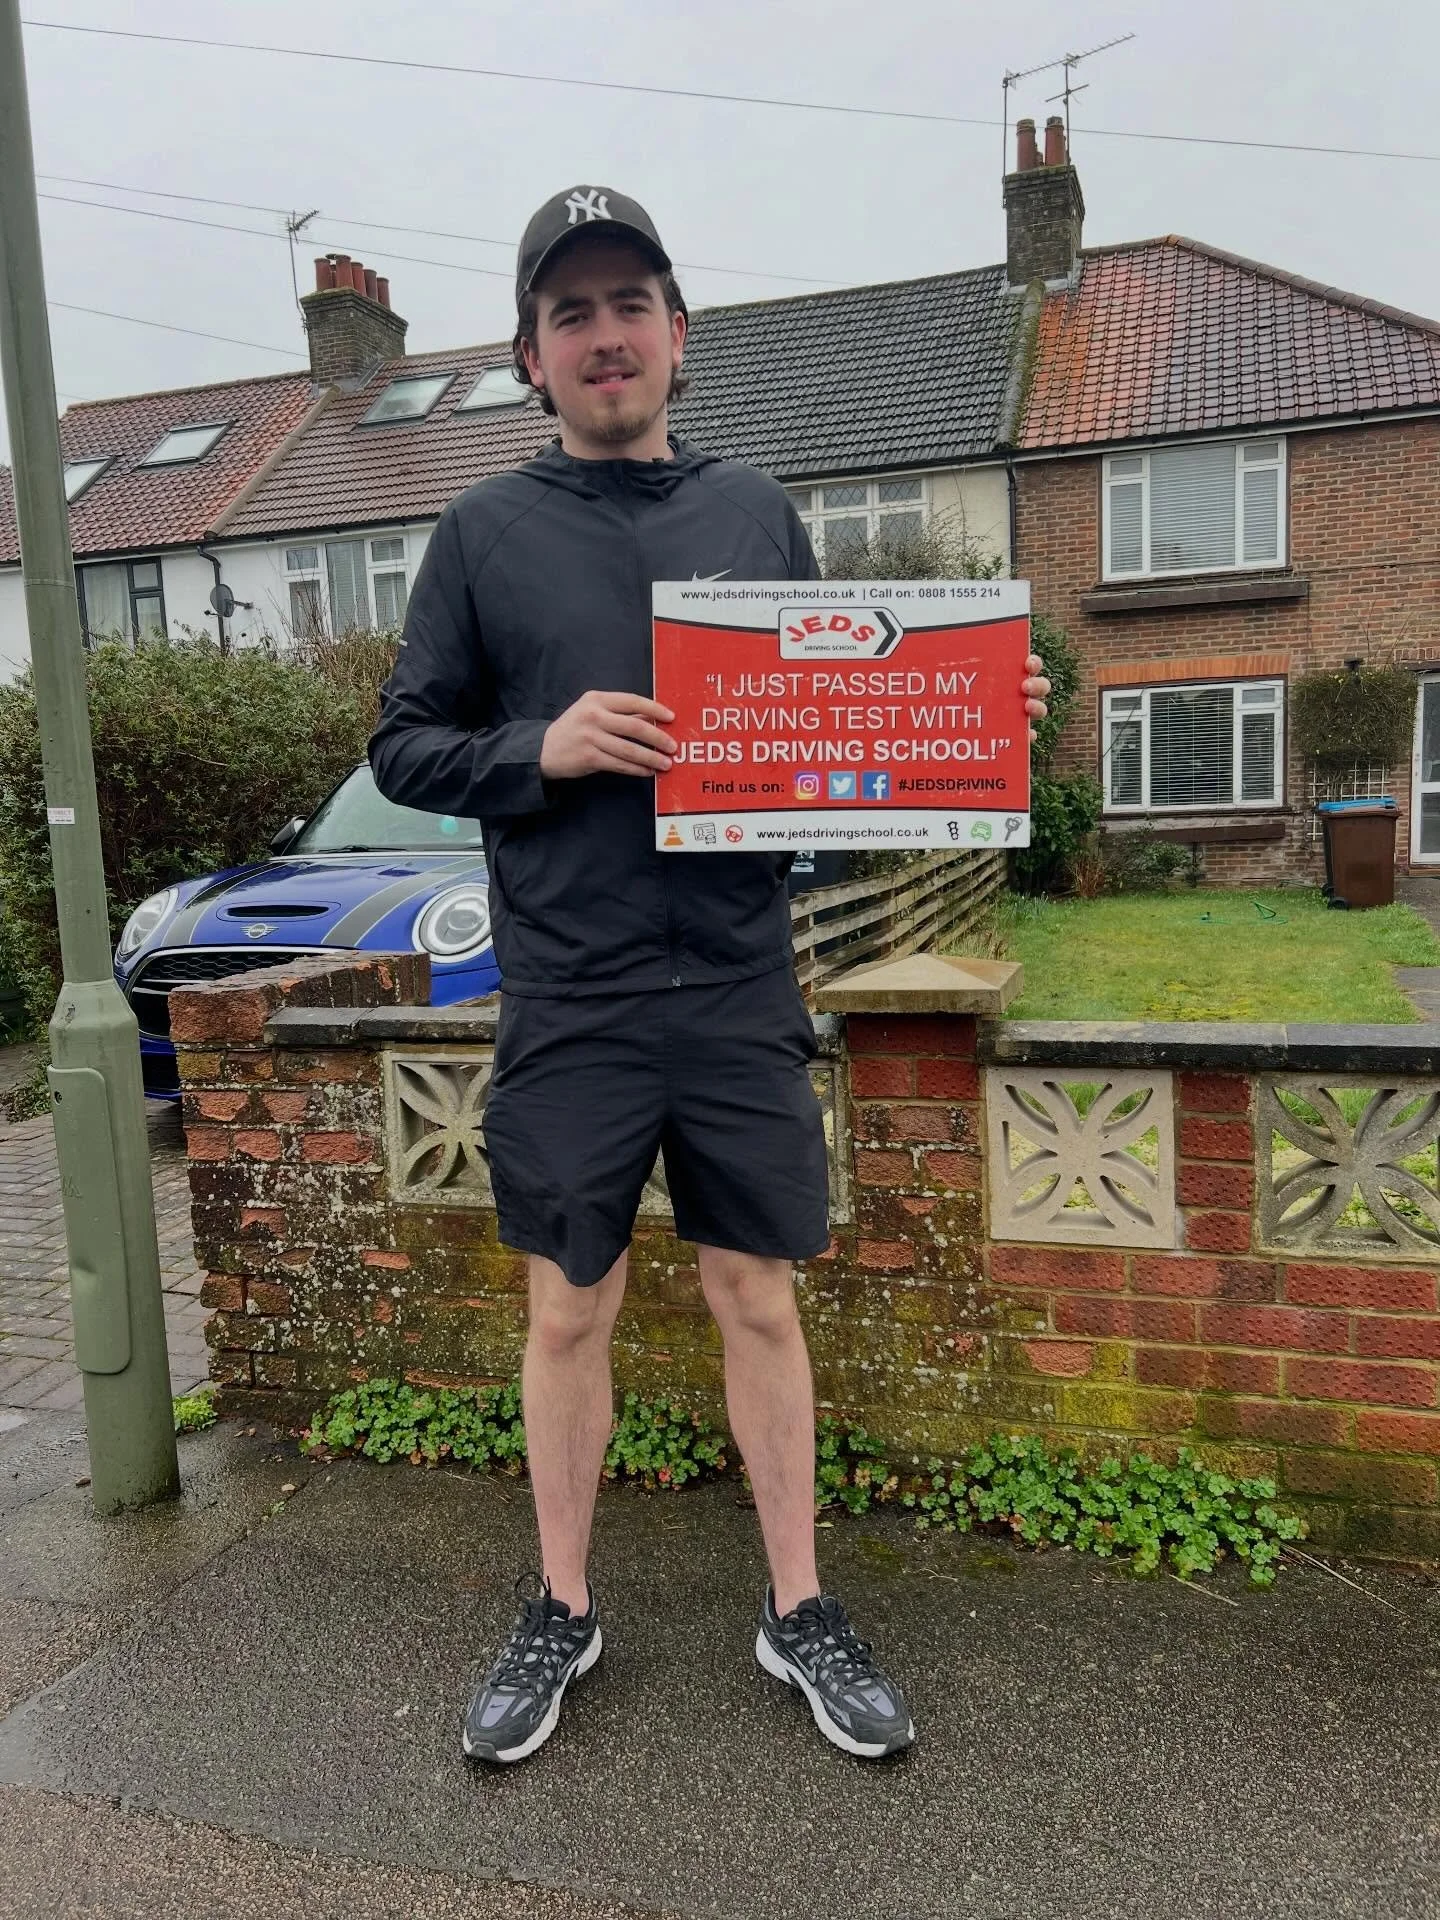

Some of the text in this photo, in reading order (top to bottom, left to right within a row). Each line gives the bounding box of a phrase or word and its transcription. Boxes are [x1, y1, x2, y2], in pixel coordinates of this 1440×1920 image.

[681, 588, 1001, 601] www.jedsdrivingschool.co.uk Call on: 0808 1555 214
[785, 614, 876, 643] JEDS
[731, 674, 803, 697] JUST
[812, 673, 926, 696] PASSED
[936, 672, 977, 695] MY
[702, 706, 983, 731] DRIVING TEST WITH
[673, 741, 744, 764] JEDS
[752, 740, 864, 763] DRIVING
[702, 781, 735, 793] Find
[739, 783, 756, 793] us
[761, 783, 785, 793] on:
[898, 778, 1006, 791] #JEDSDRIVING
[757, 827, 929, 841] www.jedsdrivingschool.co.uk
